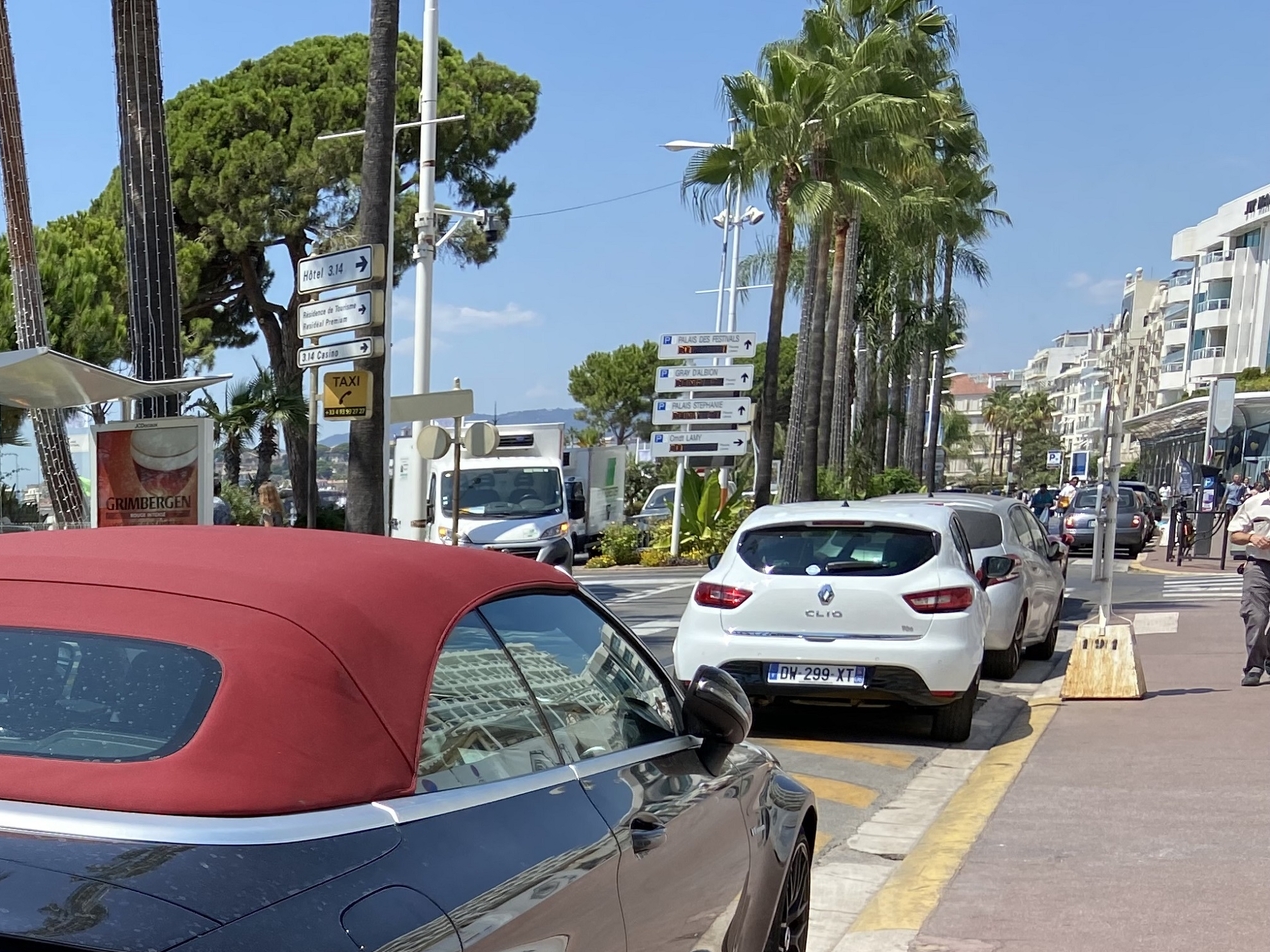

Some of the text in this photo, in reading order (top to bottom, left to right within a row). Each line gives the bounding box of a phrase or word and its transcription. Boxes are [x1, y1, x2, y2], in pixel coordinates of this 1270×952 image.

[303, 263, 343, 281] Hôtel 3.14
[327, 306, 333, 314] de
[335, 303, 356, 312] Tourisme
[302, 350, 338, 362] 3.14 Casino
[333, 376, 360, 387] TAXI
[106, 496, 191, 510] GRIMBERGEN
[805, 609, 843, 618] CLIO
[780, 666, 854, 682] DW-299-XT
